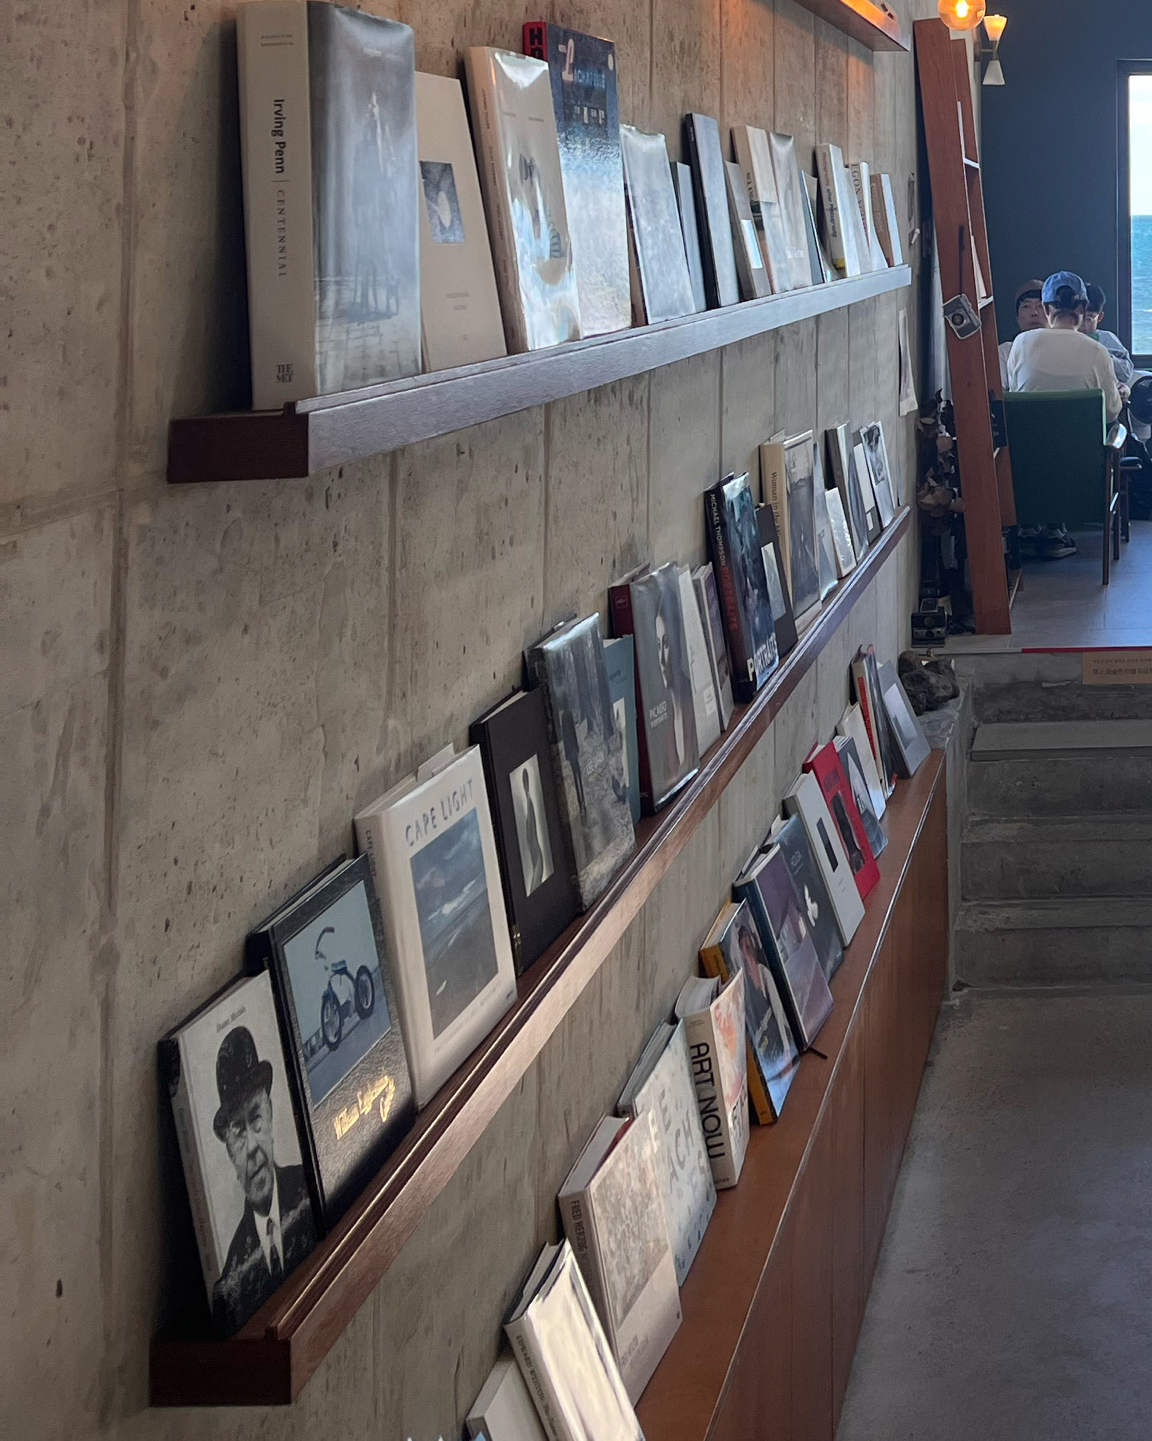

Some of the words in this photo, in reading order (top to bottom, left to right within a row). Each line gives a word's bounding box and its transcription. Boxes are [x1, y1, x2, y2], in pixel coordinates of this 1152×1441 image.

[271, 99, 286, 137] Irving
[274, 141, 286, 174] Penn
[276, 190, 287, 277] CENTENNIAL
[710, 493, 718, 525] MICHAEL
[715, 525, 726, 566] THOMPSON
[405, 807, 437, 847] CAPE
[440, 778, 473, 821] LIGHT
[365, 829, 373, 849] CAPE
[690, 1042, 715, 1087] ART
[699, 1095, 726, 1160] NOW
[570, 1199, 582, 1221] FRED
[574, 1220, 588, 1254] HERZOG
